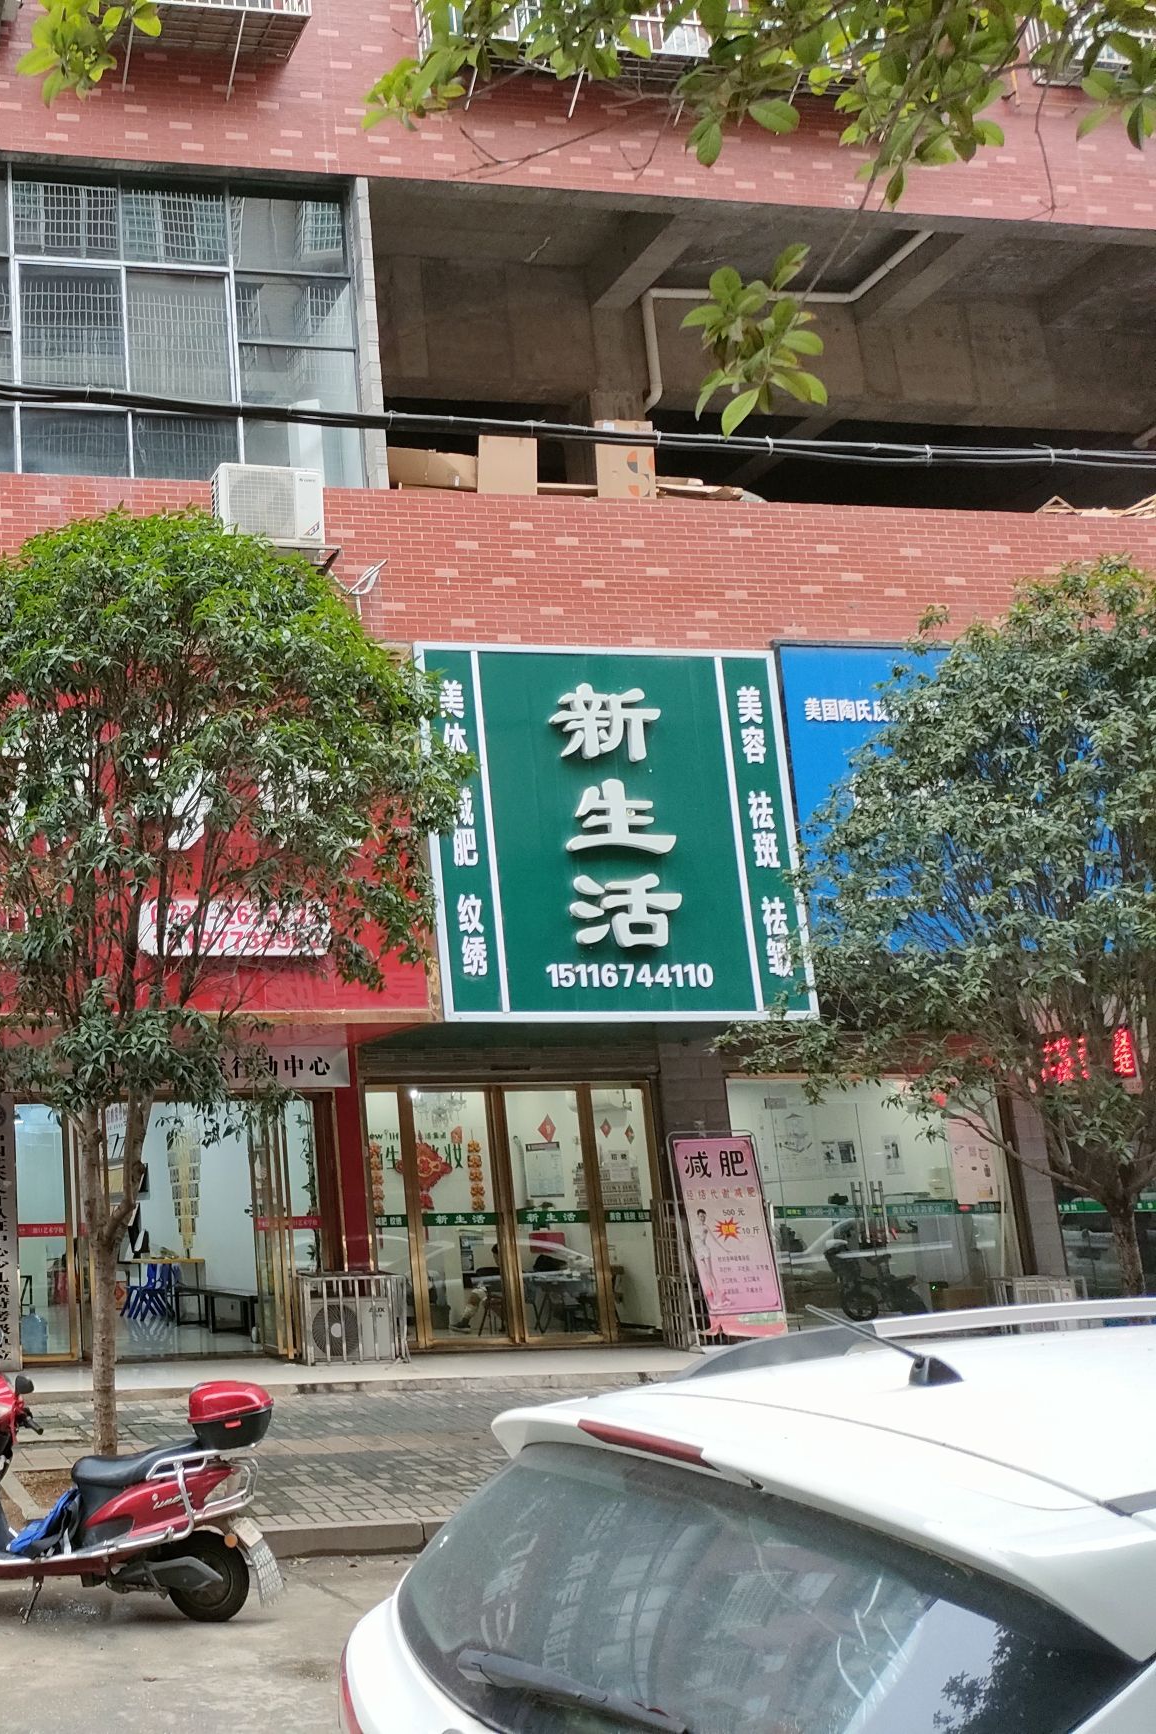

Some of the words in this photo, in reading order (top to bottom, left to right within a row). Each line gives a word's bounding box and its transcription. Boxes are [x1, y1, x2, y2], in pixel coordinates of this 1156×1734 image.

[736, 685, 767, 764] 美容
[548, 682, 684, 948] 新生活
[747, 790, 781, 869] 祛斑
[457, 893, 488, 977] 纹绣
[545, 963, 714, 988] 15116744110
[683, 1150, 749, 1179] 减肥
[435, 1214, 487, 1225] 新生活
[526, 1212, 577, 1223] 新生活
